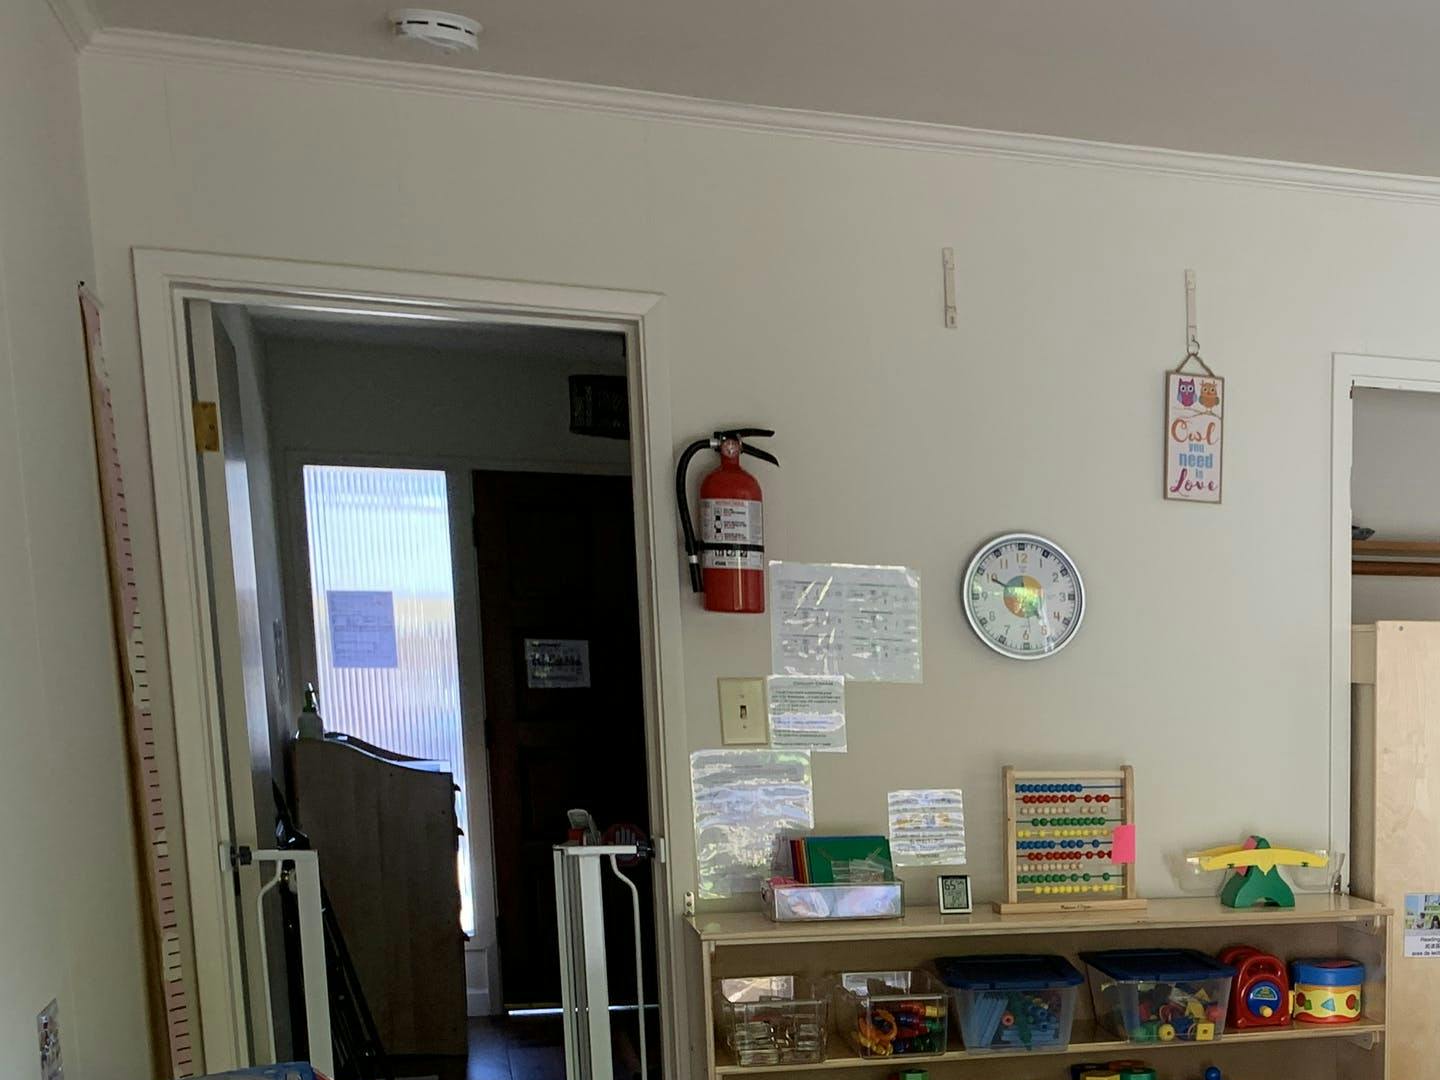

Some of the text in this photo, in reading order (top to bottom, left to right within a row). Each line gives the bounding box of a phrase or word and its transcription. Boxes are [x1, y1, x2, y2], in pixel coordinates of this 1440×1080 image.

[1179, 453, 1213, 469] need
[1195, 468, 1204, 479] is
[1170, 468, 1218, 497] Love
[1015, 552, 1028, 564] 12
[999, 559, 1009, 569] 11
[1052, 572, 1059, 583] 2
[981, 591, 988, 602] 9
[1058, 592, 1066, 602] 3
[988, 611, 996, 622] 8
[1053, 611, 1061, 622] 4
[1004, 625, 1011, 635] 7
[1022, 630, 1030, 640] 6
